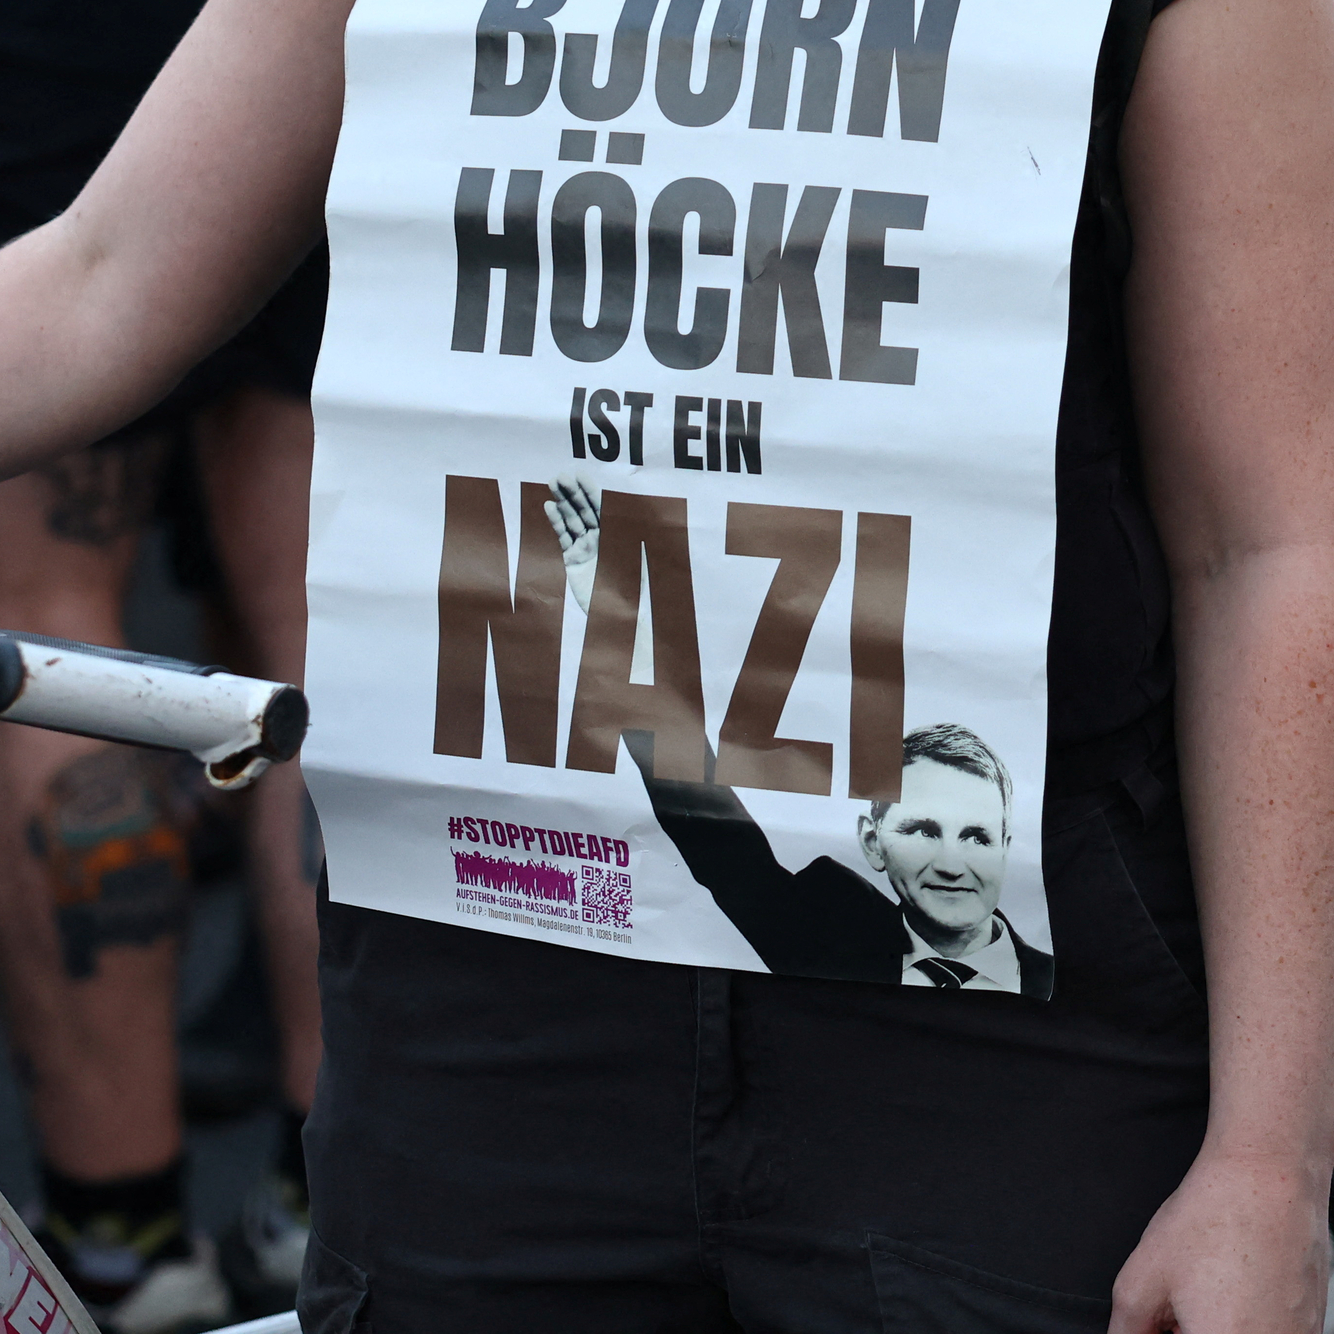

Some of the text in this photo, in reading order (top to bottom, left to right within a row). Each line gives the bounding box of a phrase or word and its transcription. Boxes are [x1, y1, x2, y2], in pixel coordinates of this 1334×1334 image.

[450, 129, 929, 386] HÖCKE
[570, 387, 762, 476] IST EIN
[433, 474, 912, 804] NAZI
[448, 816, 630, 868] #STOPPTDIEAFD
[456, 888, 579, 921] AUFSTEHEN-GEGEN-RASSISMUS.DE
[488, 908, 512, 922] Thomas
[613, 931, 632, 944] Berlin
